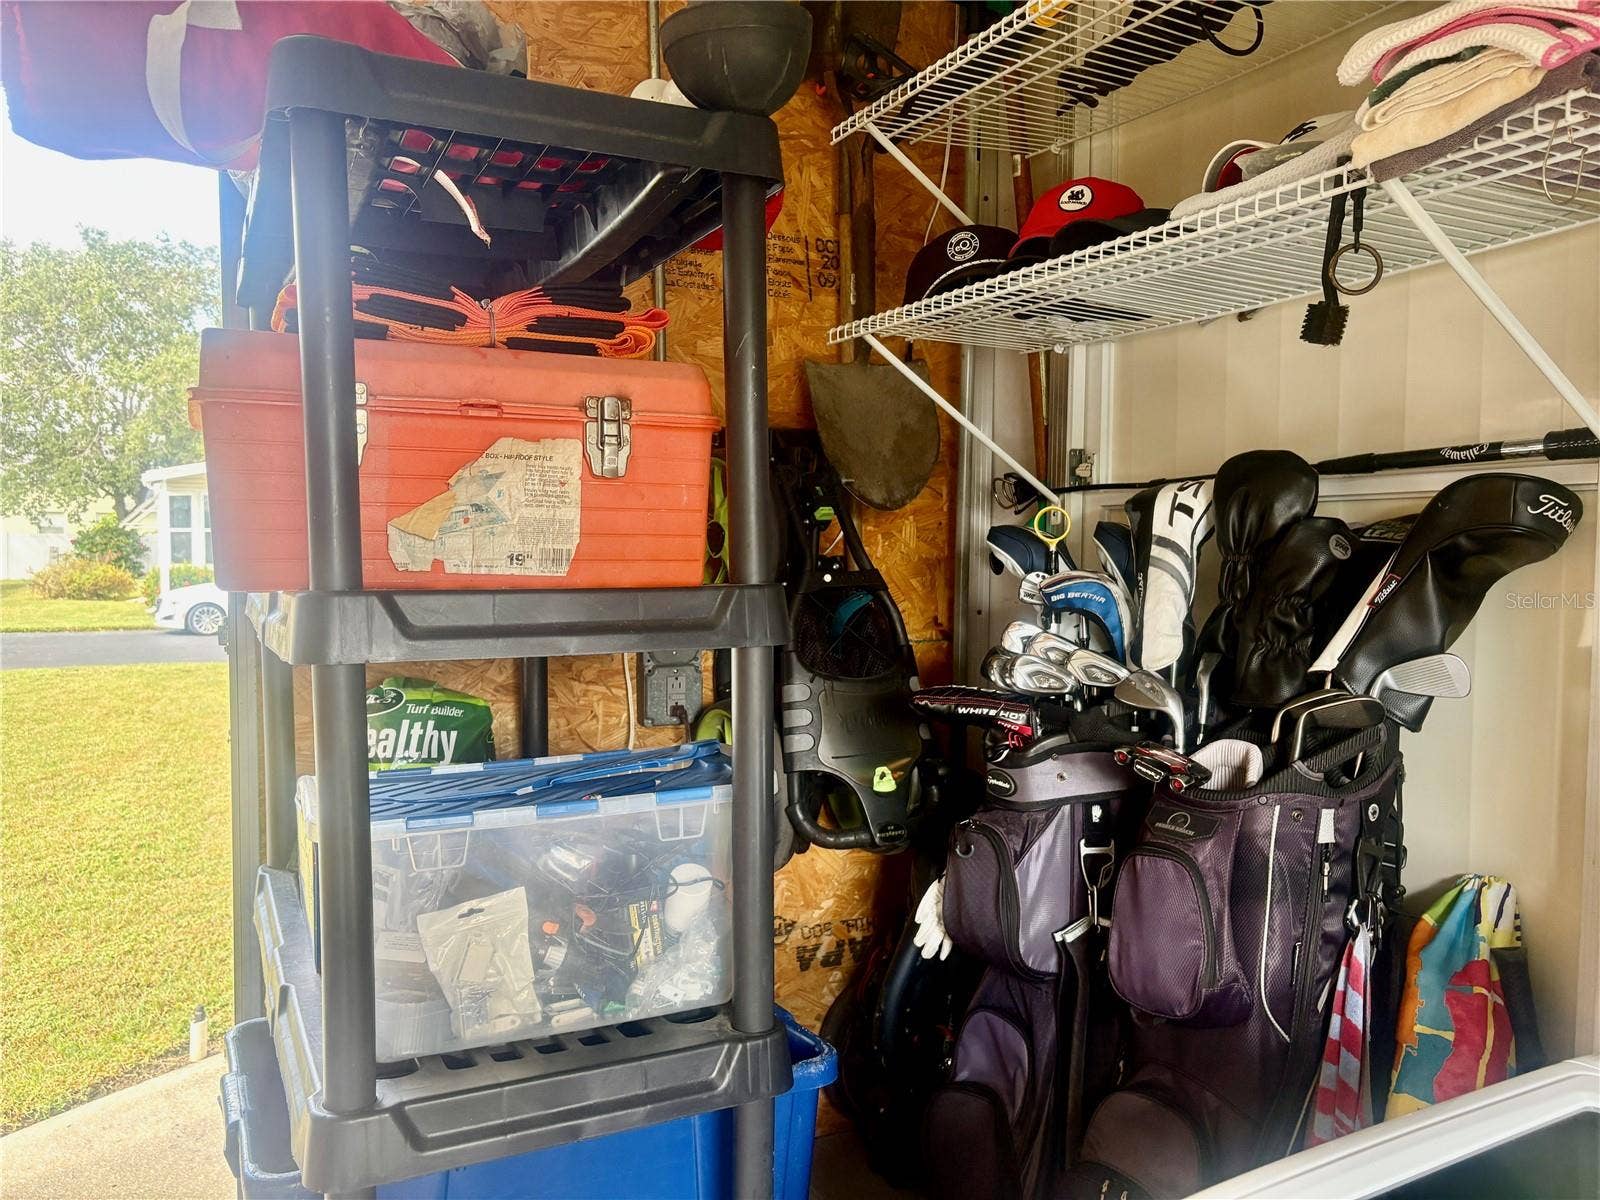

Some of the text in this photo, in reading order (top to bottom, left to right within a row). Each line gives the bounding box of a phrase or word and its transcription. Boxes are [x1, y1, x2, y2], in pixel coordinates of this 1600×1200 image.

[820, 255, 840, 270] 20
[1440, 442, 1490, 461] Callaway
[507, 553, 533, 566] 19"
[1050, 591, 1106, 604] BIG BERTHA
[405, 703, 464, 717] Turf Builder
[957, 707, 1027, 721] WHITE HOT
[997, 720, 1020, 732] PRO
